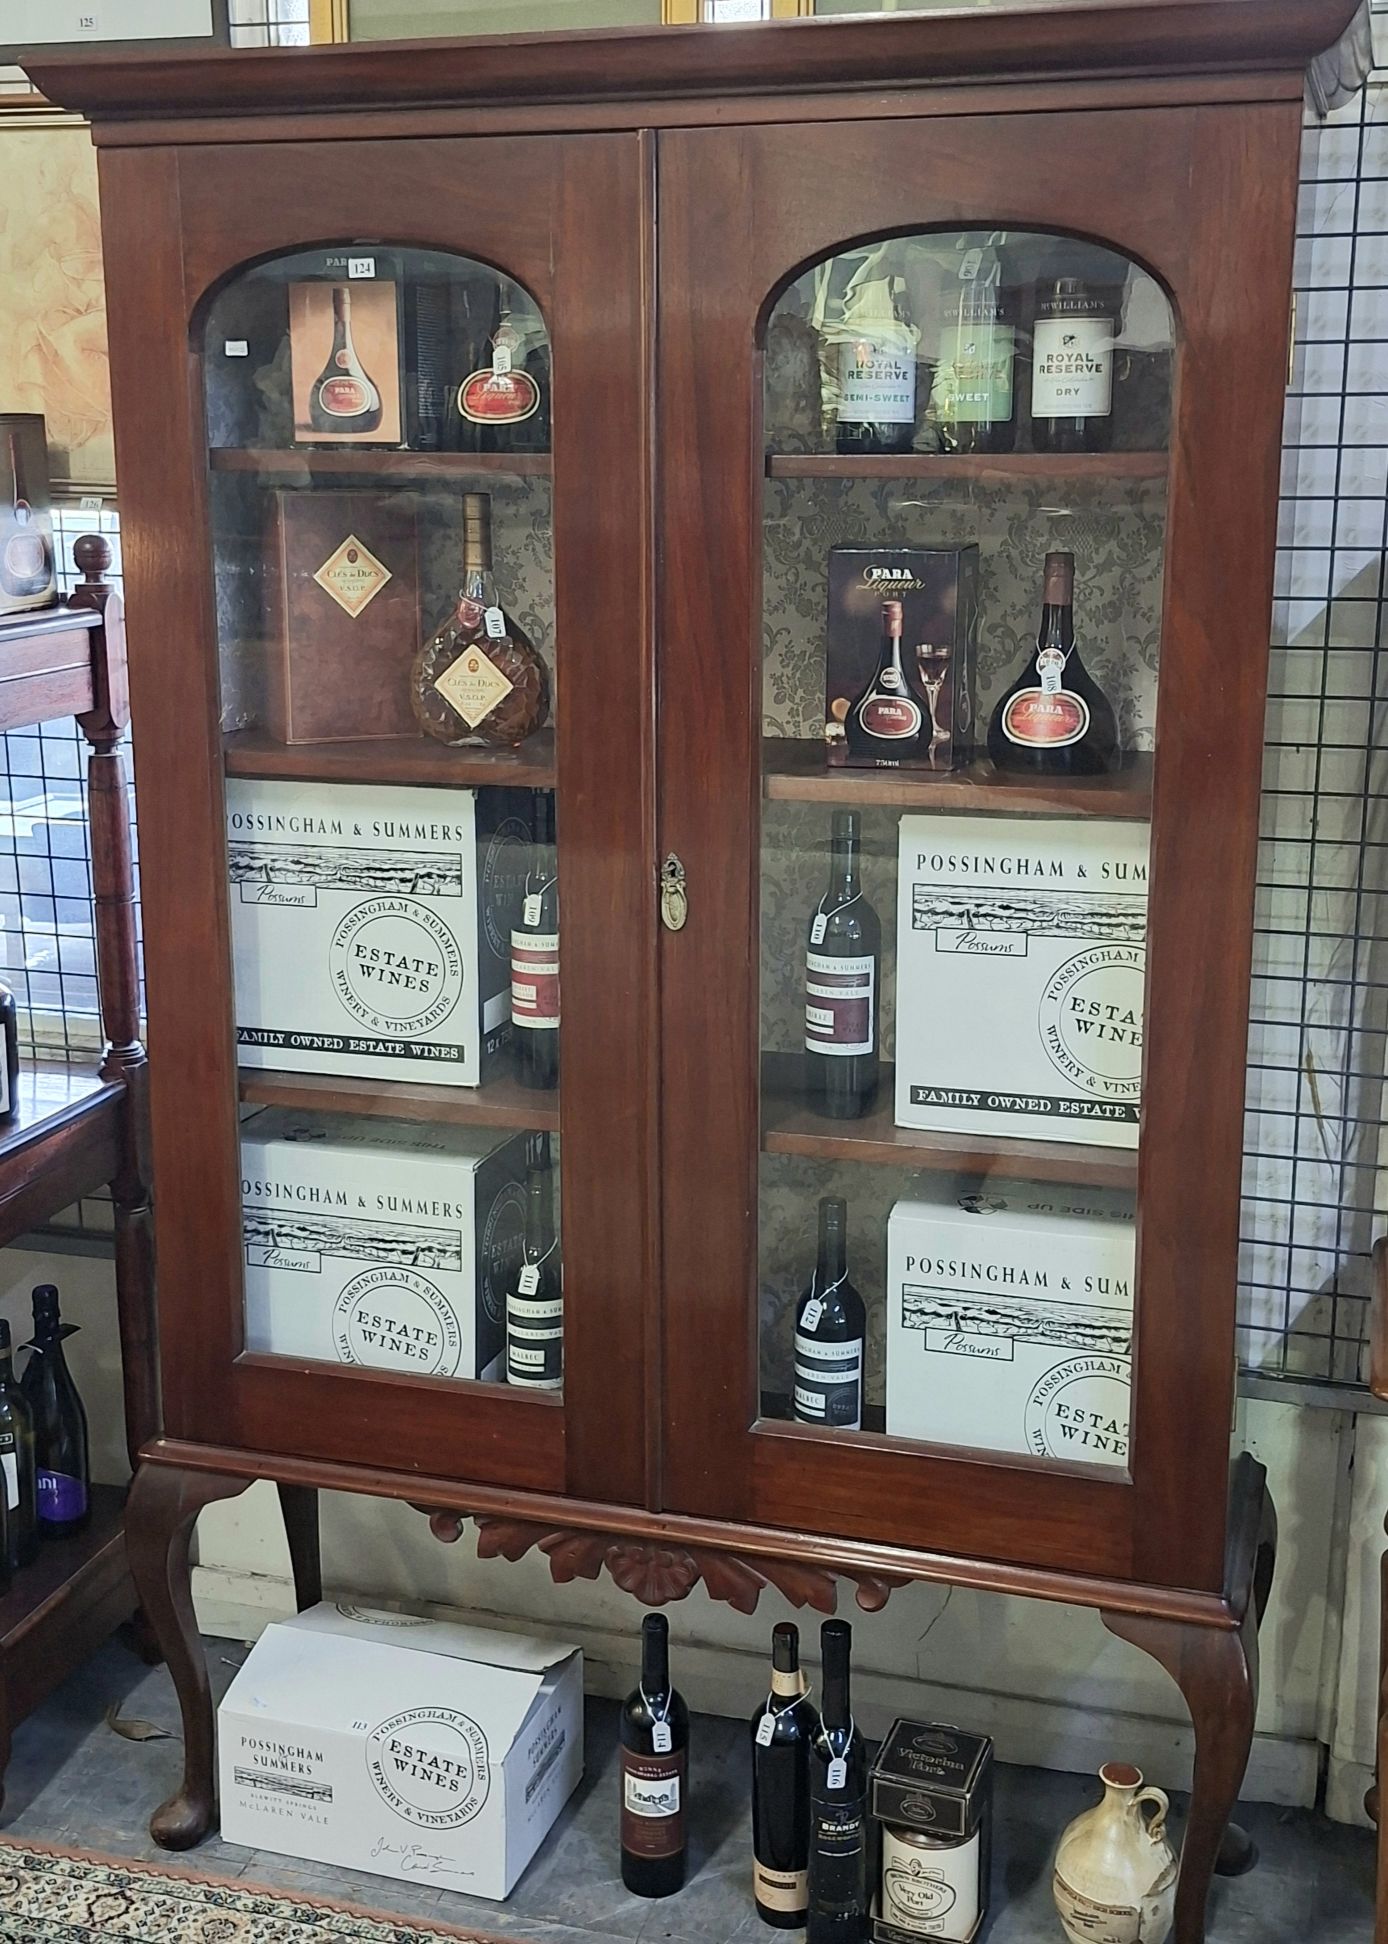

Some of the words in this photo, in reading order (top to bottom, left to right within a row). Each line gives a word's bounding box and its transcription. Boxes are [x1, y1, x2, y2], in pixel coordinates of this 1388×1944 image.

[79, 17, 94, 28] 125
[326, 257, 348, 267] PAR
[354, 262, 371, 275] 124
[1039, 363, 1103, 374] RESERVE
[1046, 352, 1095, 364] ROYAL
[847, 370, 909, 381] RESERVE
[843, 394, 910, 403] SEMI-SWEET
[949, 392, 990, 402] SWEET
[1056, 387, 1080, 396] DRY
[856, 564, 926, 593] Liqueur
[871, 568, 914, 580] PARA
[490, 618, 502, 634] 107
[1045, 675, 1057, 692] 108
[878, 706, 903, 716] PARA
[1029, 703, 1064, 715] PARA
[231, 812, 343, 835] OSSINGHAM
[353, 825, 362, 836] &
[373, 821, 463, 842] SUMMERS
[916, 853, 1065, 877] POSSINGHAM
[1077, 864, 1088, 878] &
[256, 884, 306, 905] Possums
[527, 905, 537, 923] 109
[335, 901, 409, 949] POSSINGHAM
[412, 908, 420, 918] &
[422, 914, 459, 977] SUMMERS
[813, 923, 823, 940] 110
[955, 931, 1014, 953] Possums
[353, 943, 440, 978] ESTATE
[359, 963, 430, 993] WINES
[1047, 950, 1140, 1002] POSSINGHAM
[336, 969, 370, 1018] WINERY
[370, 1016, 380, 1027] &
[384, 995, 451, 1032] VINEYARDS
[1069, 996, 1138, 1026] ESTA
[1074, 1017, 1143, 1048] WINE
[290, 1033, 344, 1049] OWNED
[349, 1039, 405, 1055] ESTATE
[409, 1043, 459, 1059] WINES
[1046, 1024, 1085, 1079] WINERY
[1086, 1075, 1097, 1088] &
[916, 1088, 982, 1107] FAMILY
[987, 1095, 1052, 1112] OWNED
[1058, 1100, 1126, 1118] ESTATE
[242, 1178, 348, 1206] OSSINGHAM
[357, 1195, 367, 1208] &
[376, 1194, 464, 1219] SUMMERS
[1026, 1202, 1053, 1212] UP
[1064, 1204, 1104, 1217] SIDE
[262, 1249, 311, 1270] Possums
[523, 1274, 534, 1289] 111
[905, 1255, 1049, 1288] POSSINGHAM
[1060, 1276, 1071, 1290] &
[338, 1271, 410, 1314] POSSINGHAM
[412, 1280, 421, 1289] &
[422, 1286, 458, 1348] SUMMERS
[805, 1307, 818, 1325] 112
[356, 1310, 438, 1347] ESTATE
[361, 1328, 429, 1361] WINES
[943, 1333, 1001, 1357] Possums
[1032, 1360, 1121, 1407] POSSINGHAM
[1060, 1423, 1127, 1457] WINE
[656, 1733, 667, 1748] 114
[759, 1723, 771, 1741] 115
[241, 1735, 324, 1763] POSSINGHAM
[372, 1710, 458, 1742] POSSINGHAM
[457, 1720, 466, 1728] &
[465, 1725, 487, 1781] SUMMERS
[253, 1754, 313, 1775] SUMMERS
[388, 1739, 468, 1779] ESTATE
[393, 1757, 460, 1792] WINES
[831, 1768, 841, 1786] 116
[372, 1760, 404, 1808] WINERY
[404, 1807, 412, 1816] &
[416, 1796, 478, 1824] VINEYARDS
[240, 1799, 293, 1816] McLAREN
[300, 1812, 329, 1825] VALE
[821, 1820, 860, 1832] BRANDY
[898, 1883, 915, 1897] Very
[917, 1891, 934, 1900] Old
[906, 1895, 923, 1906] Port
